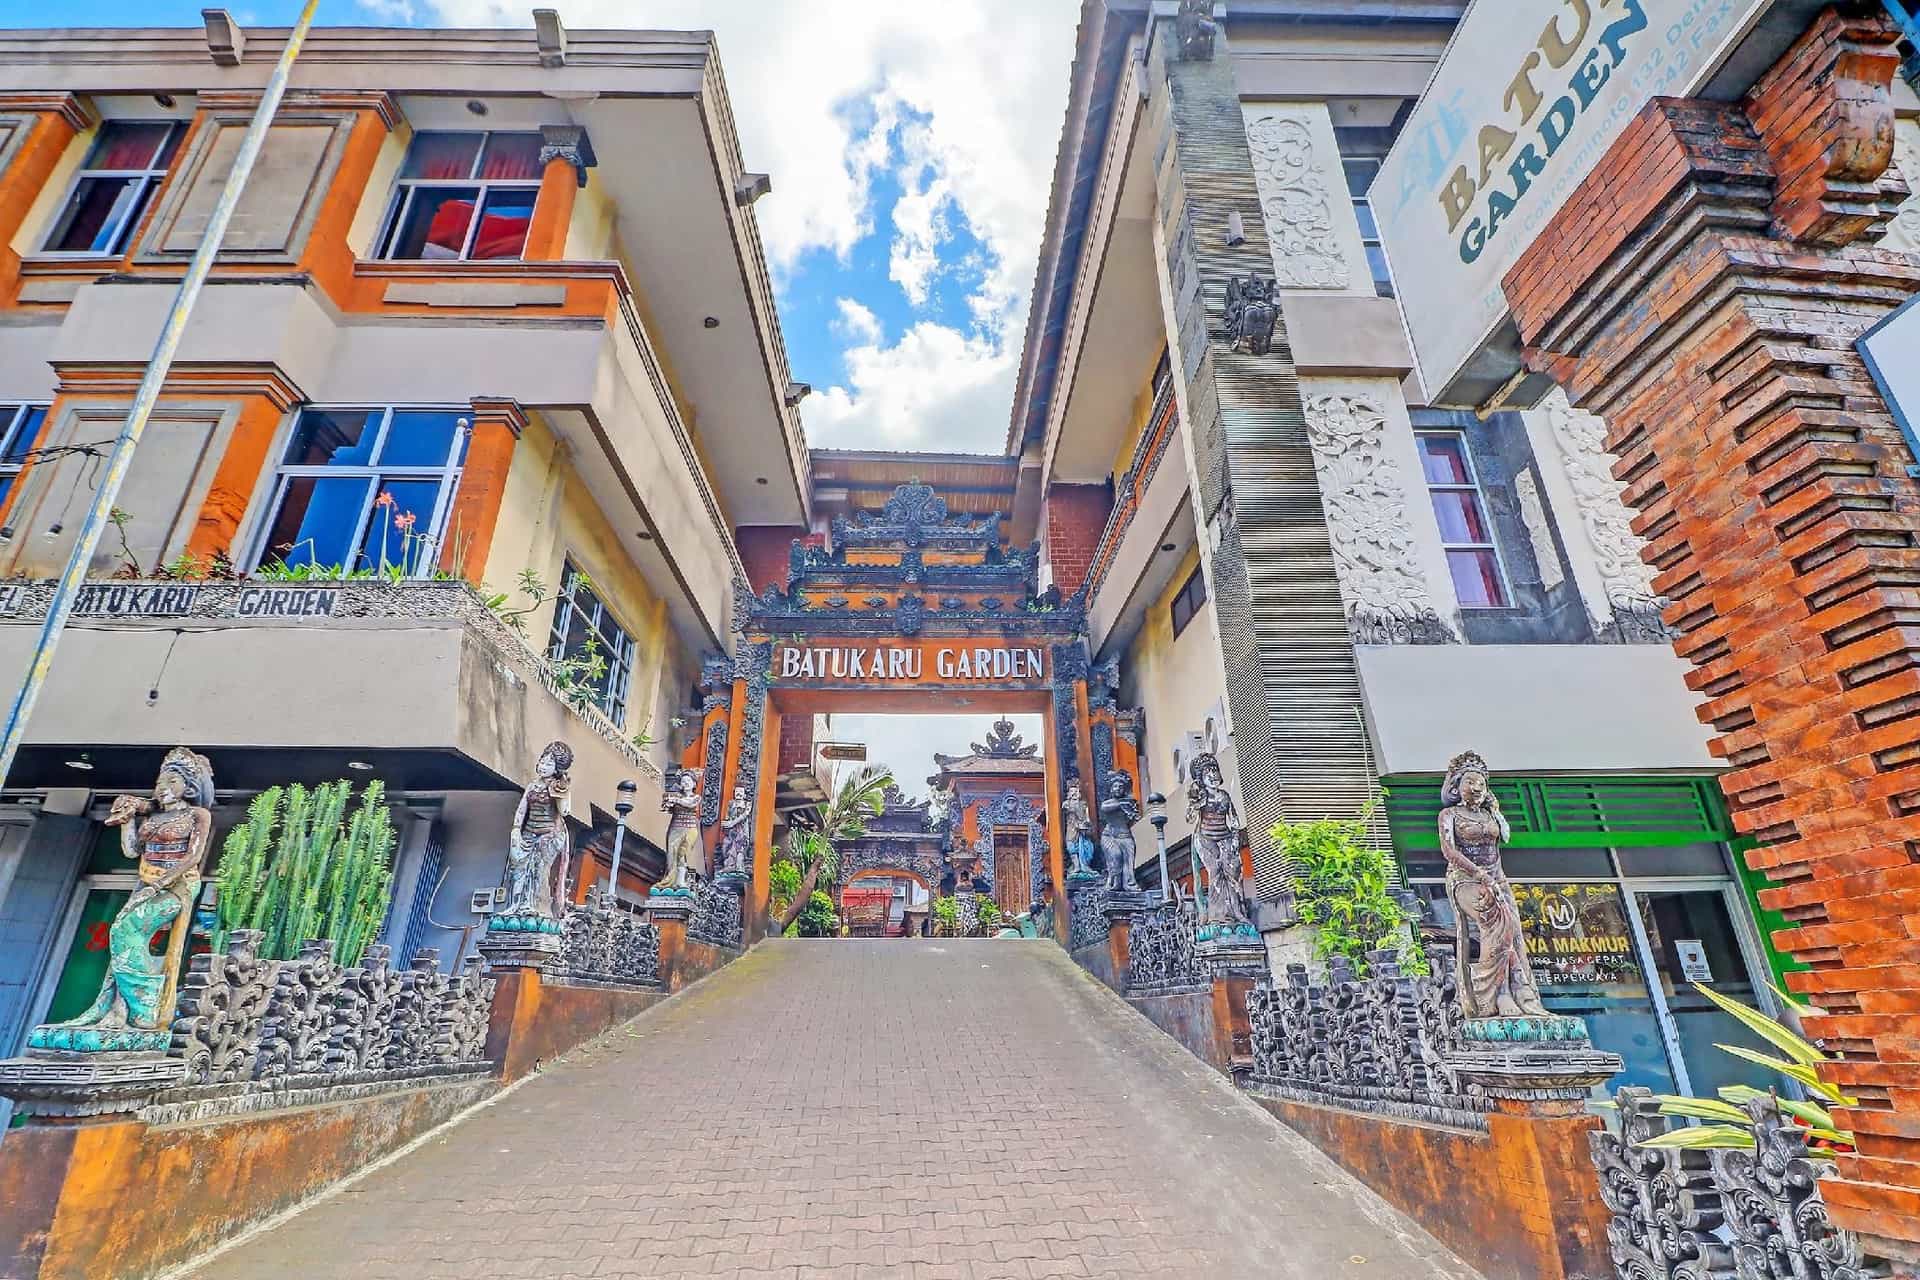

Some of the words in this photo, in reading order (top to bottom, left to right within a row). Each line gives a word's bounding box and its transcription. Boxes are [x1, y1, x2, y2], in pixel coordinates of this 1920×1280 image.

[1439, 0, 1611, 234] BATU
[1459, 0, 1648, 264] GARDEN
[239, 589, 337, 615] GARDEN
[782, 647, 922, 679] BATUKARU
[936, 647, 1043, 679] GARDEN
[1552, 936, 1630, 953] MAKMUR
[1587, 954, 1624, 965] CEPAT
